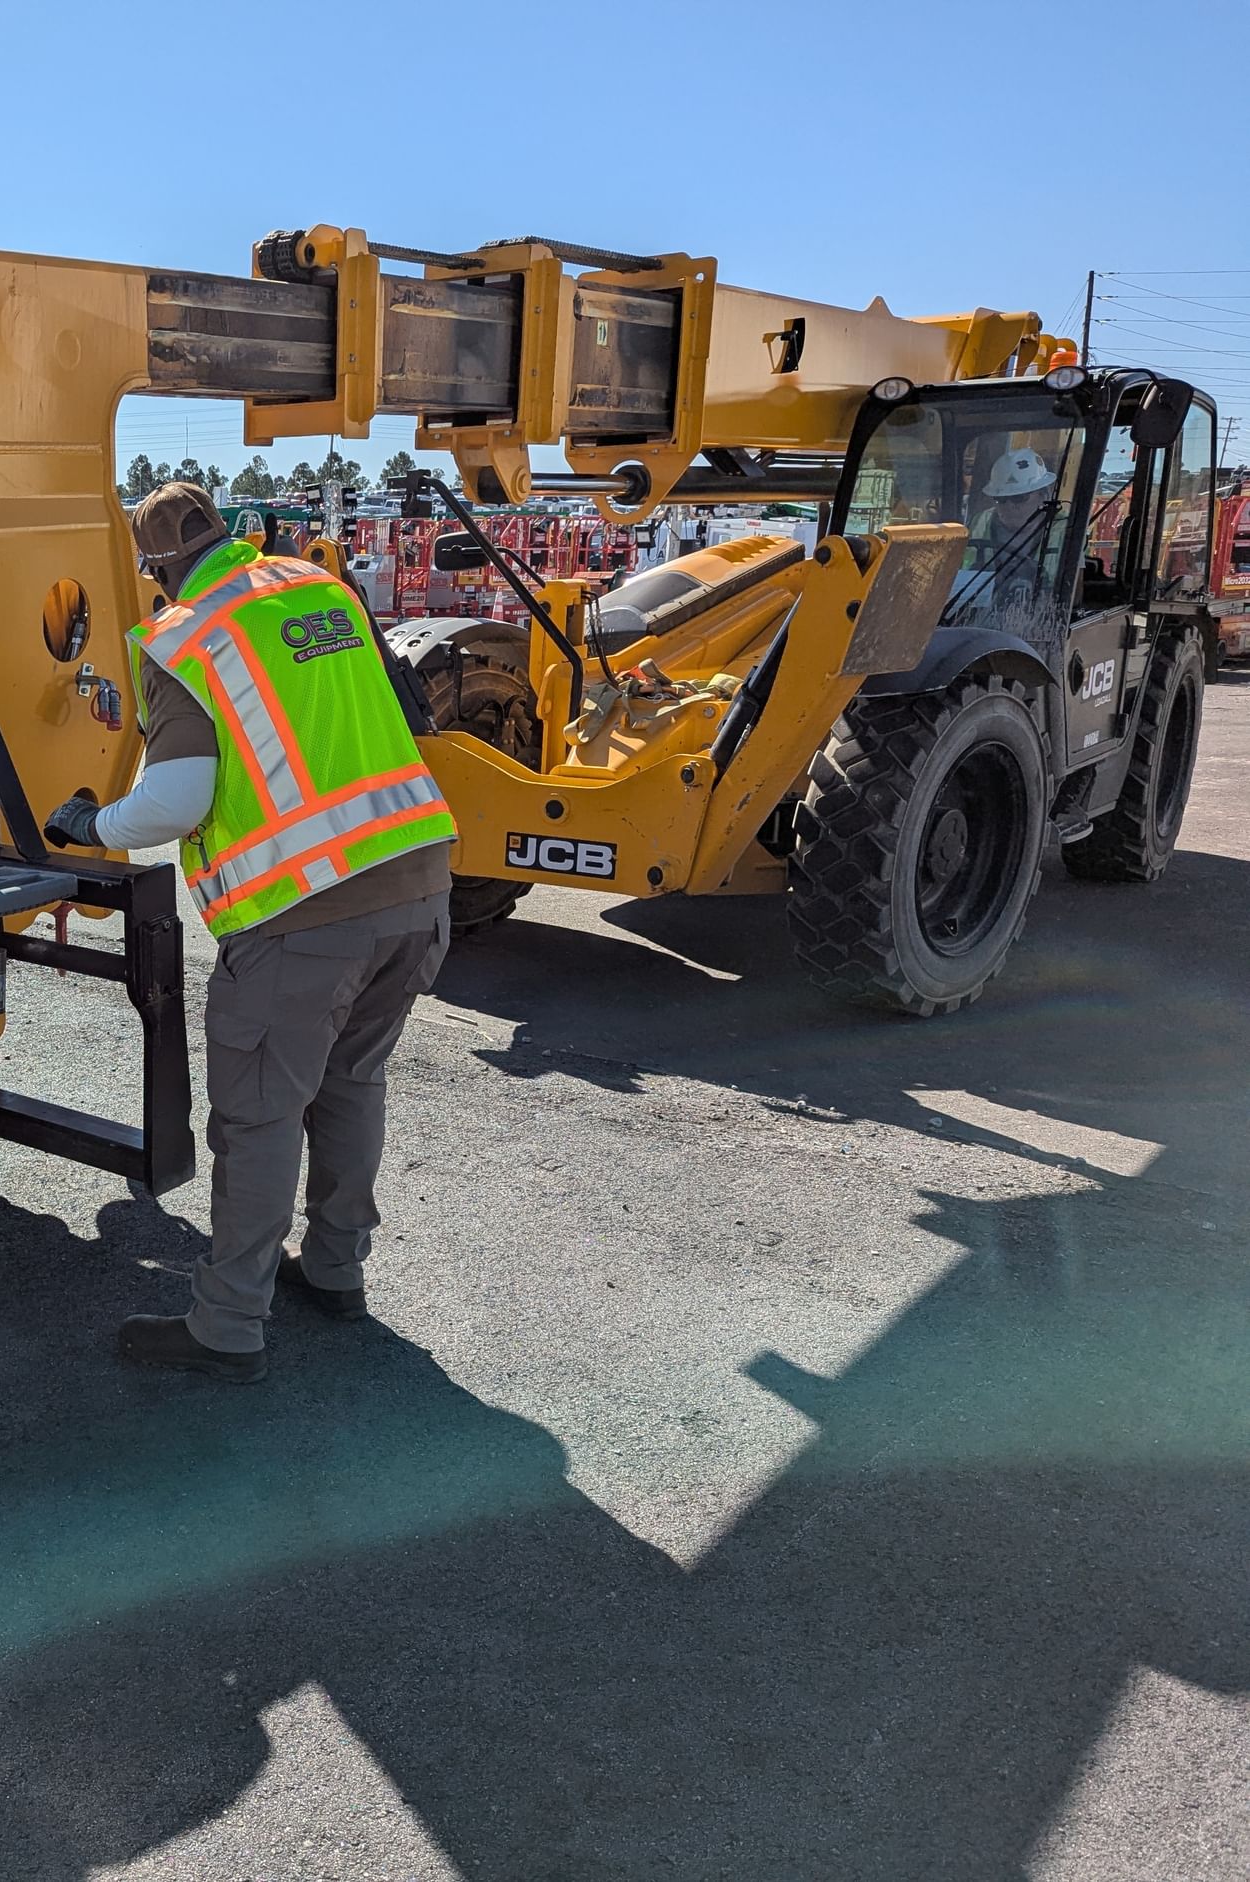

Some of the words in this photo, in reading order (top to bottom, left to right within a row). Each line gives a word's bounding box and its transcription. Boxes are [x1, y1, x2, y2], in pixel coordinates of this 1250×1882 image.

[281, 607, 355, 648] OES
[297, 638, 362, 661] EQUIPMENT
[1082, 659, 1115, 700] JCB
[508, 837, 614, 876] JCB
